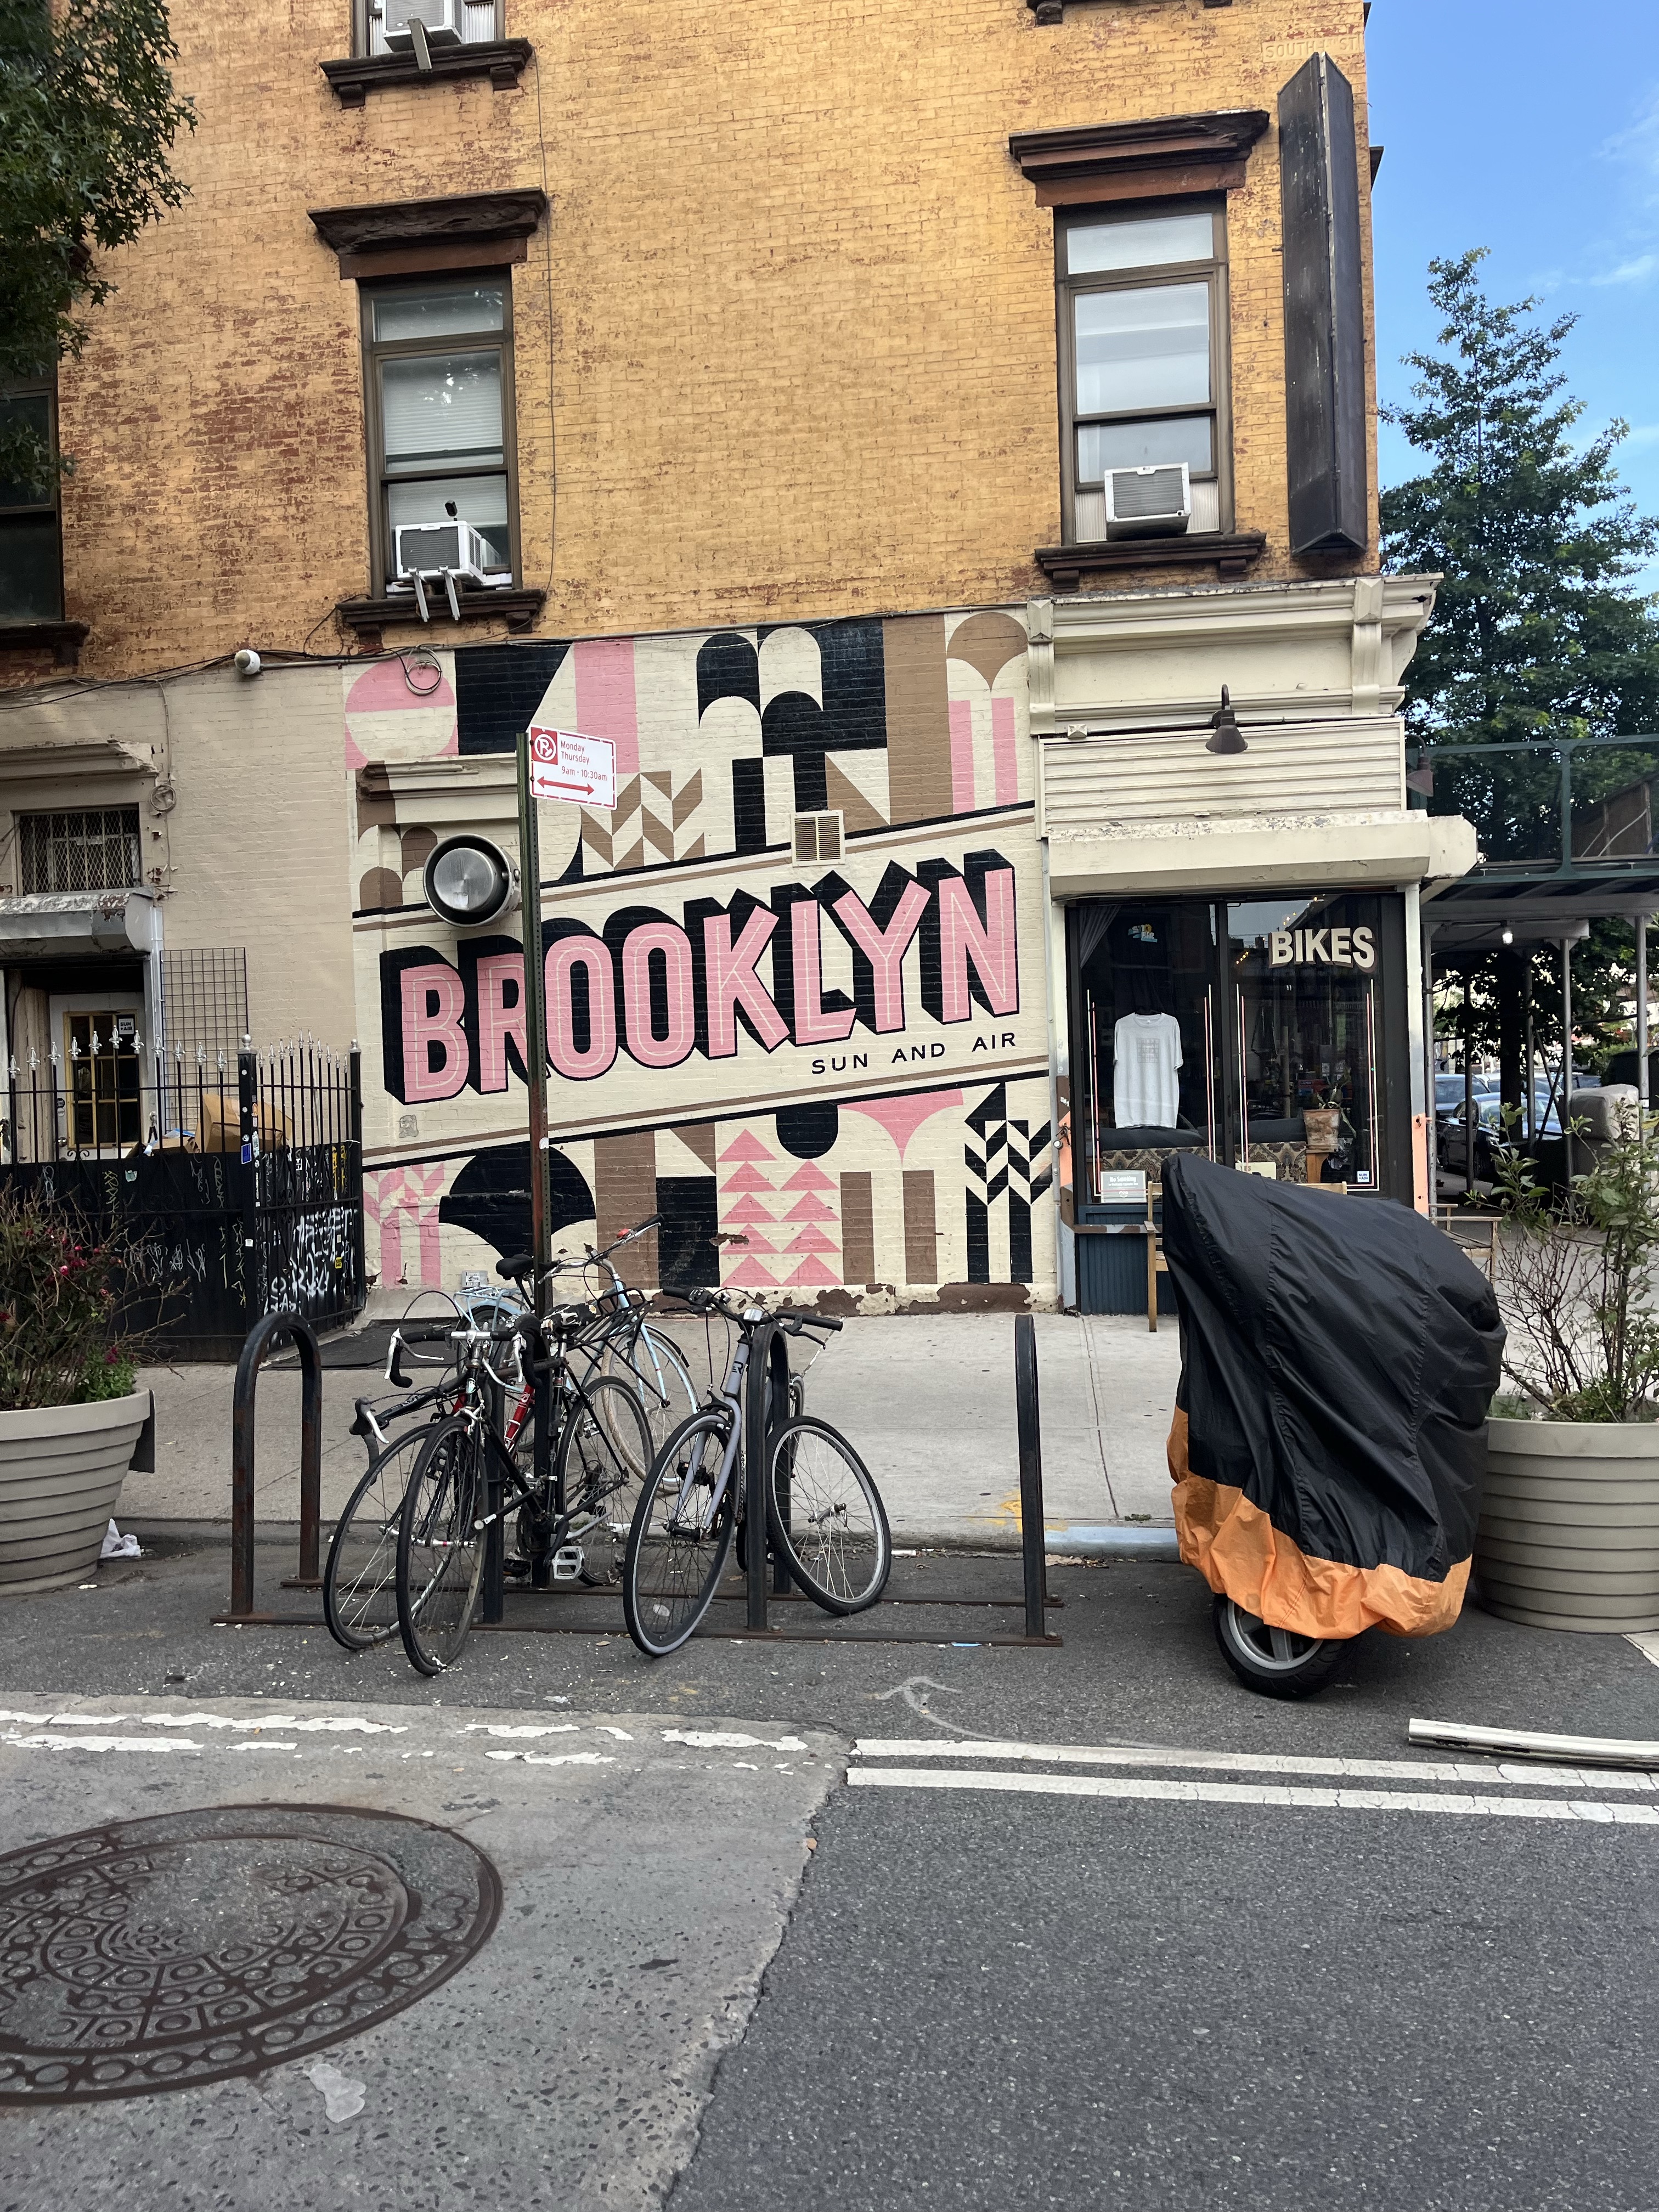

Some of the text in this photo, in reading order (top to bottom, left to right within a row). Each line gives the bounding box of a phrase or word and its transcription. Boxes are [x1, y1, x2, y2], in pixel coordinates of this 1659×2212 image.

[560, 740, 585, 754] Monday
[561, 751, 590, 765] Thursday
[561, 766, 575, 776] 9am
[581, 769, 607, 781] 10:30am
[1268, 926, 1377, 973] BIKES
[380, 849, 1020, 1105] BROOKLYN
[811, 1032, 1016, 1075] SUN AND AIR
